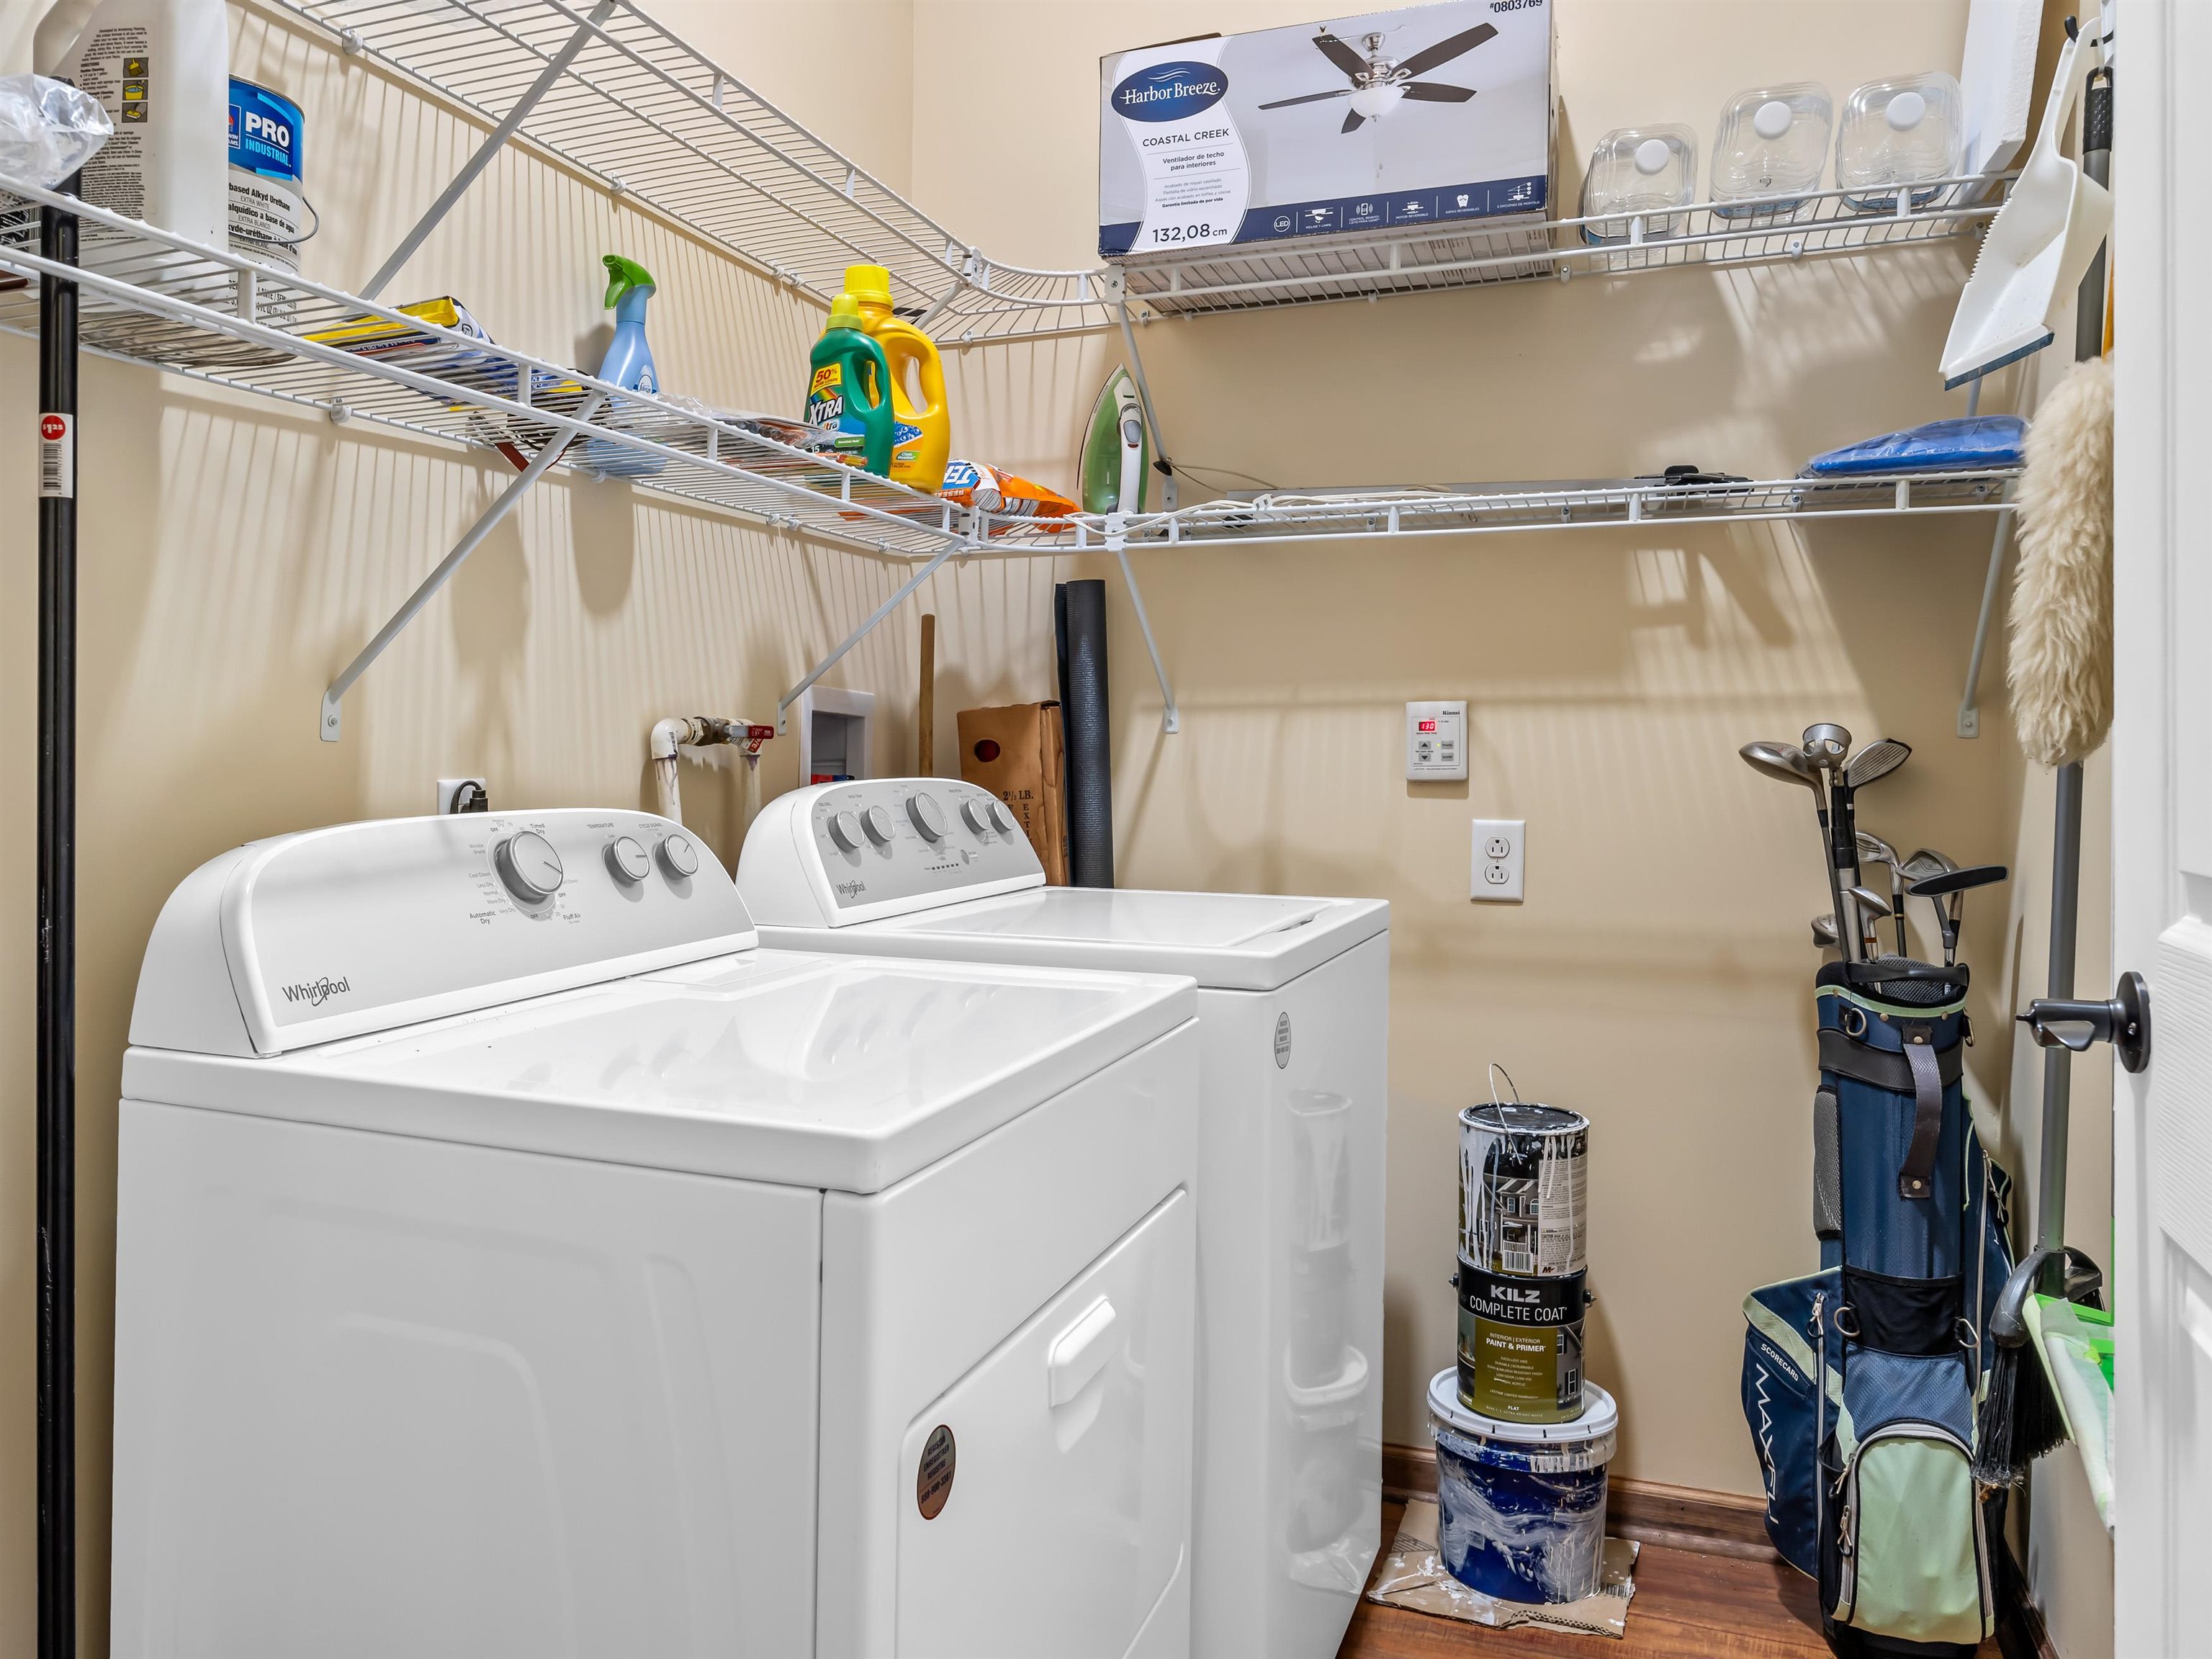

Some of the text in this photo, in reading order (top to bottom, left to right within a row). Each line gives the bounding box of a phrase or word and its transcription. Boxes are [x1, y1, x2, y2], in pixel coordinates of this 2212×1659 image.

[1490, 0, 1542, 12] #0803769
[1120, 86, 1172, 104] Harbor
[246, 112, 289, 147] PRO
[1143, 128, 1229, 147] COASTAL CREEK
[240, 196, 269, 210] EXTRA WHITE
[251, 189, 268, 201] Alkyd
[270, 194, 290, 211] Urethane
[238, 215, 271, 230] EXTRA BLANCO
[266, 213, 278, 225] base
[1153, 224, 1210, 242] 132,08
[816, 368, 837, 382] 50%
[810, 395, 844, 426] XTRA
[1019, 791, 1033, 800] LB.
[836, 881, 866, 899] Whirlpool
[282, 976, 350, 1006] Whirlpool
[1491, 1285, 1539, 1303] KILZ
[1470, 1295, 1529, 1321] COMPLETE
[1486, 1339, 1506, 1348] PAINT
[1761, 1343, 1798, 1381] SCORECARD
[1756, 1363, 1779, 1524] MAXFLI
